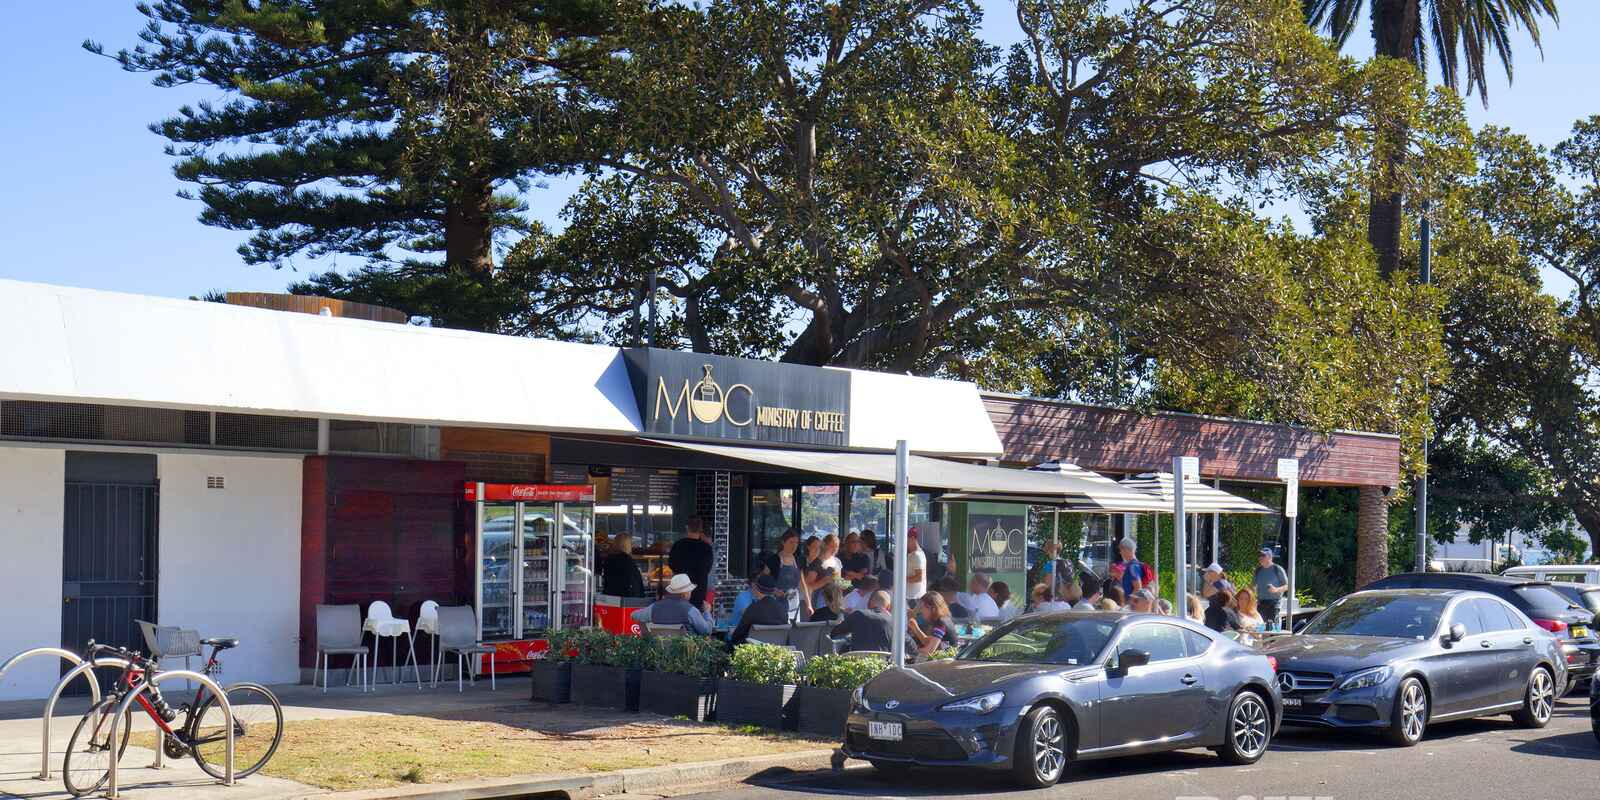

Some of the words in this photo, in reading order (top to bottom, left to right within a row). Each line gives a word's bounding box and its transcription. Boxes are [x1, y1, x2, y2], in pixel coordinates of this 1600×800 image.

[654, 374, 753, 426] MOC
[756, 406, 799, 429] MINISTRY
[801, 410, 812, 430] OF
[814, 411, 845, 432] COFFEE
[512, 486, 536, 497] Coca-Cola
[971, 528, 1023, 555] MOC
